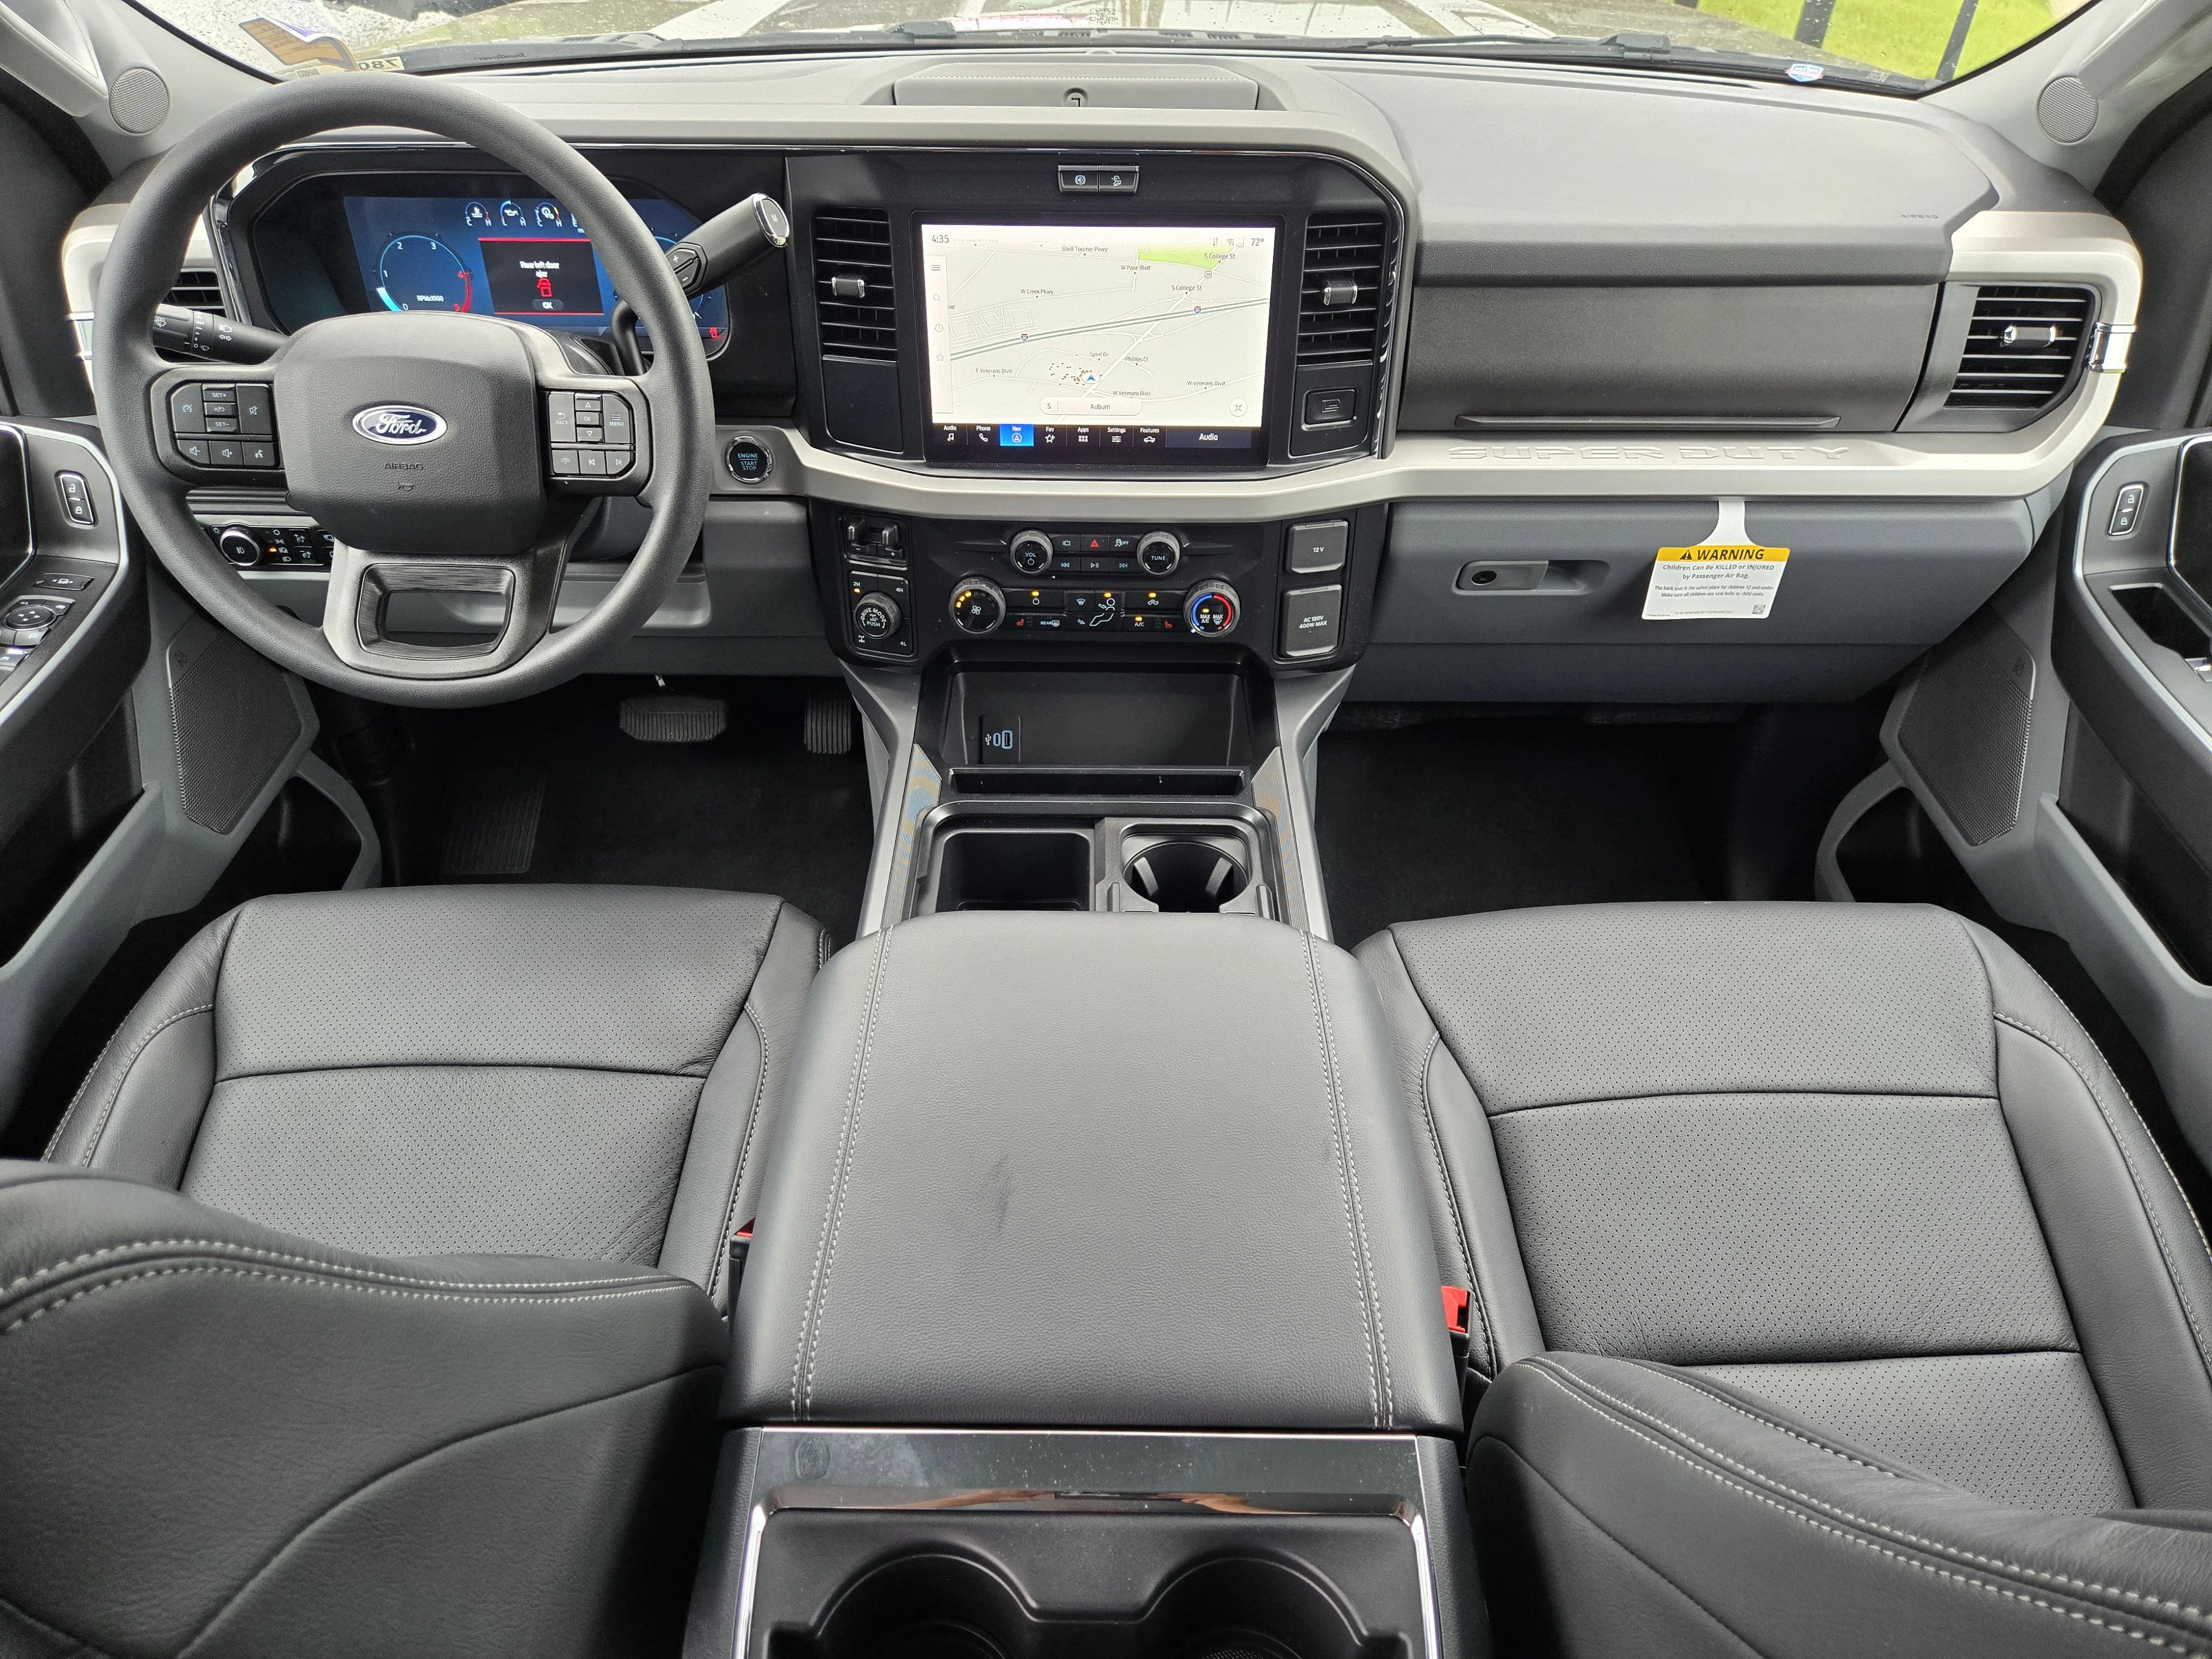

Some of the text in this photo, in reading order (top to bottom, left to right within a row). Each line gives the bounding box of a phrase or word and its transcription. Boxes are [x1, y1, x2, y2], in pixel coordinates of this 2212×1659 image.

[931, 234, 950, 243] 4:35
[375, 413, 427, 434] Ford
[1448, 445, 1850, 460] SUPER DUTY
[1697, 549, 1765, 560] WARNING
[860, 608, 886, 623] DRIVE MODE
